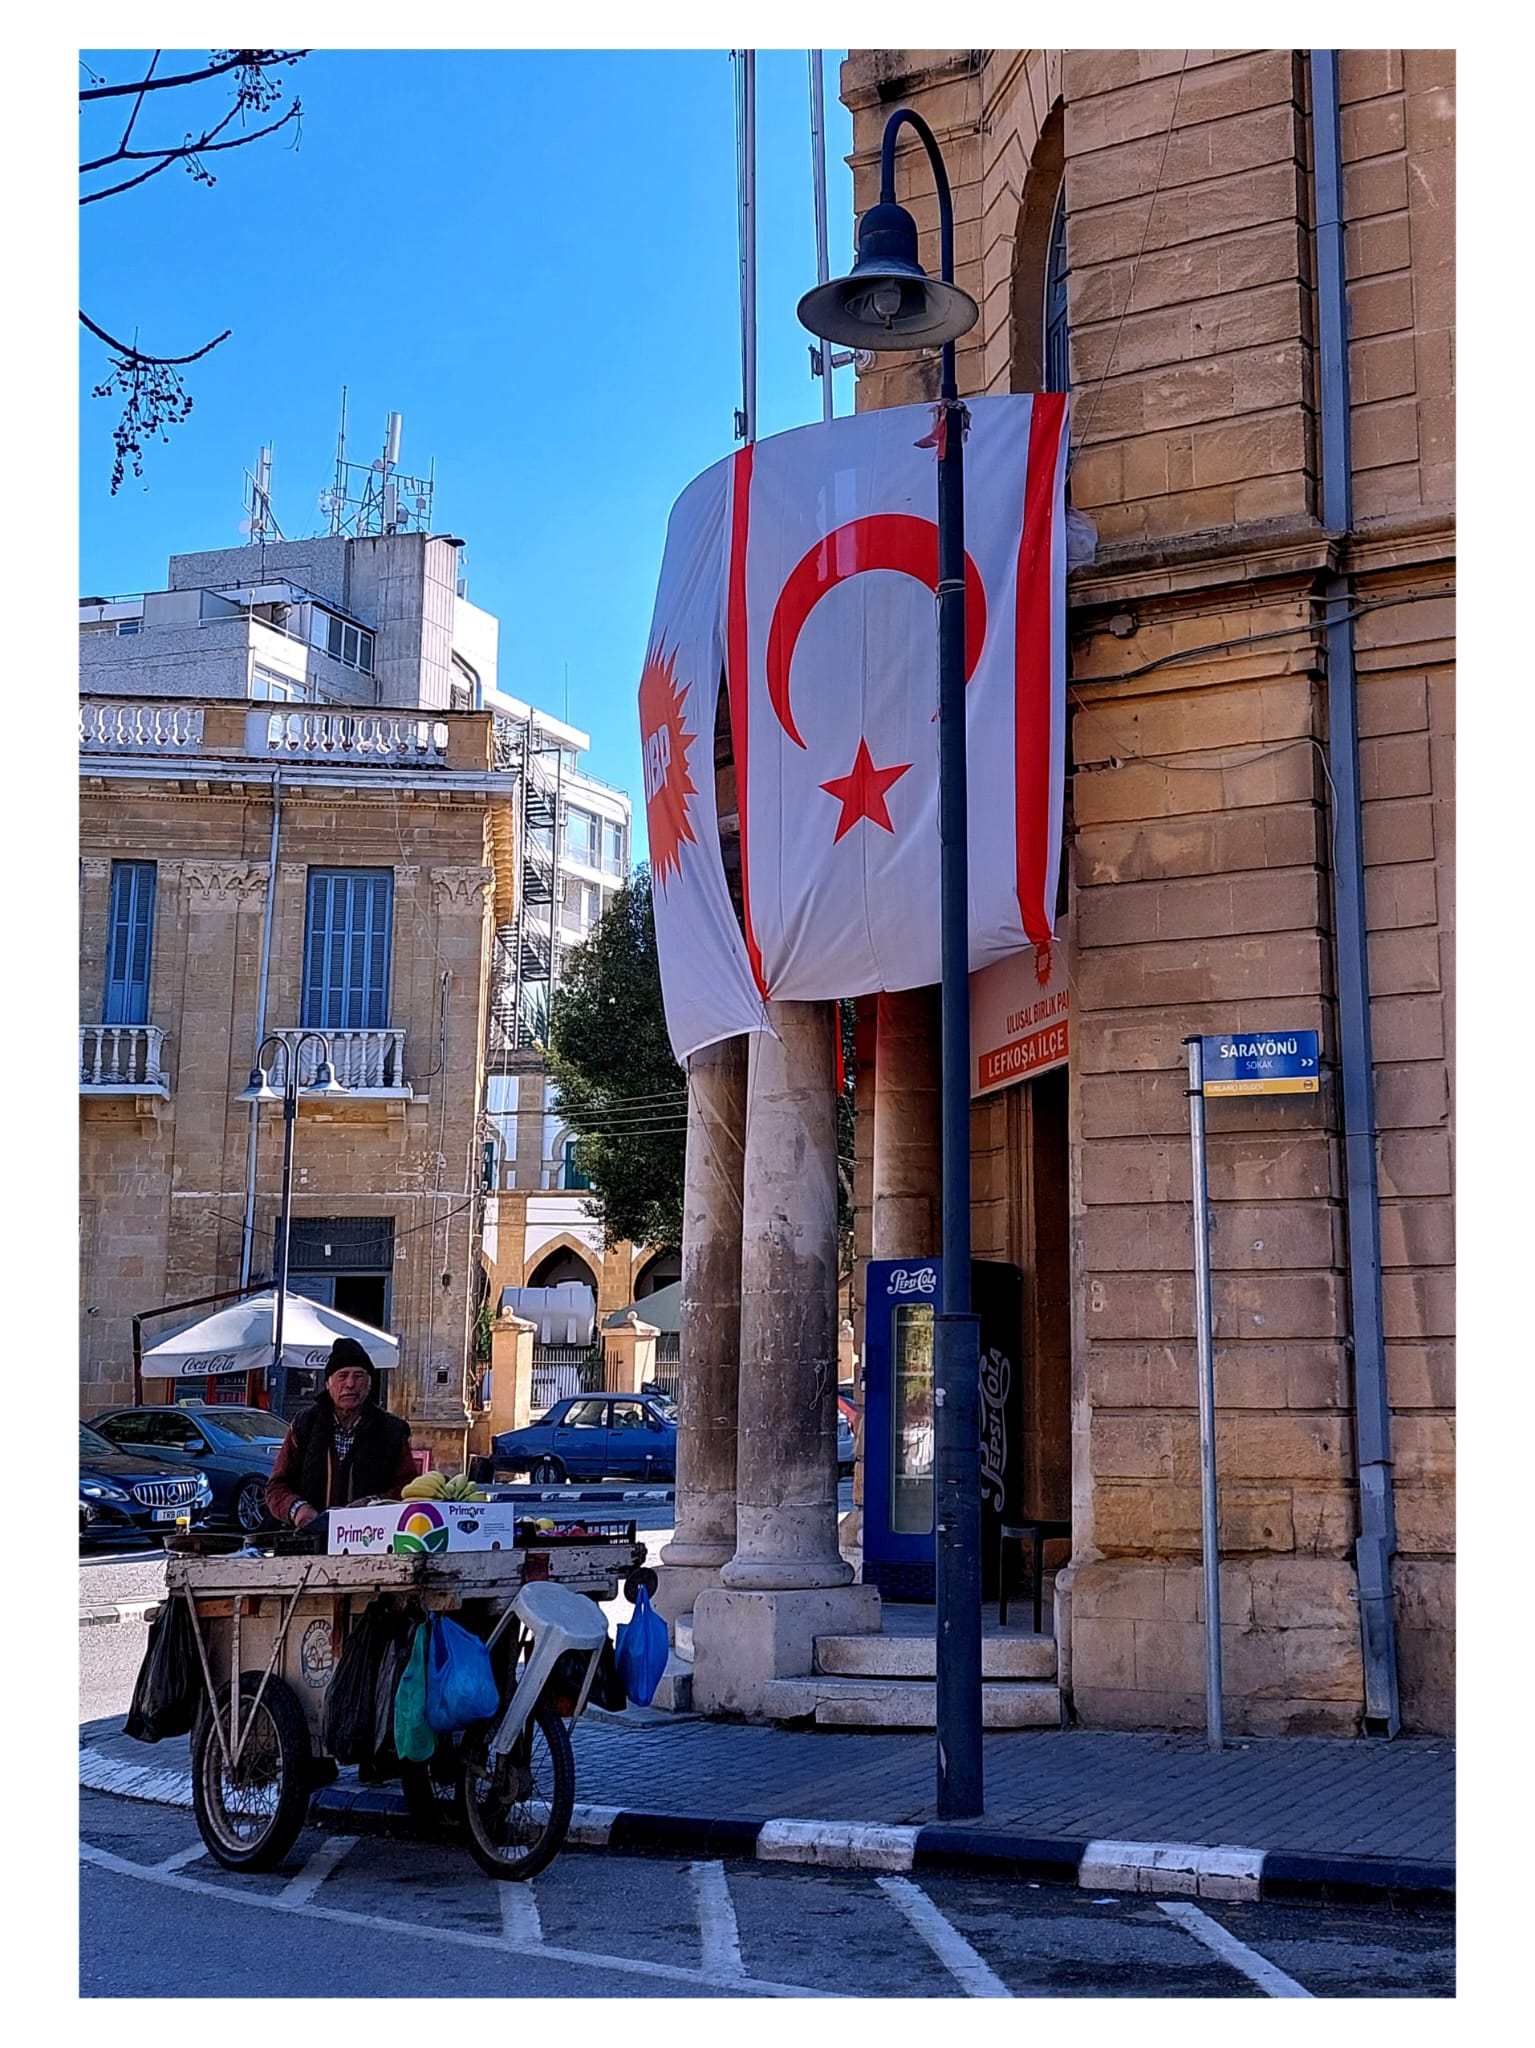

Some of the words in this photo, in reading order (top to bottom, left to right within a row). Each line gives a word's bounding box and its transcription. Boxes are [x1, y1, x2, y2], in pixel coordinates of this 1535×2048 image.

[1007, 1011, 1033, 1034] ULUSAL
[988, 1042, 1036, 1078] LEFKOŞA
[1038, 1028, 1065, 1059] İLÇE
[1220, 1038, 1298, 1059] SARAYÖNÜ
[1245, 1059, 1274, 1071] SOKAK
